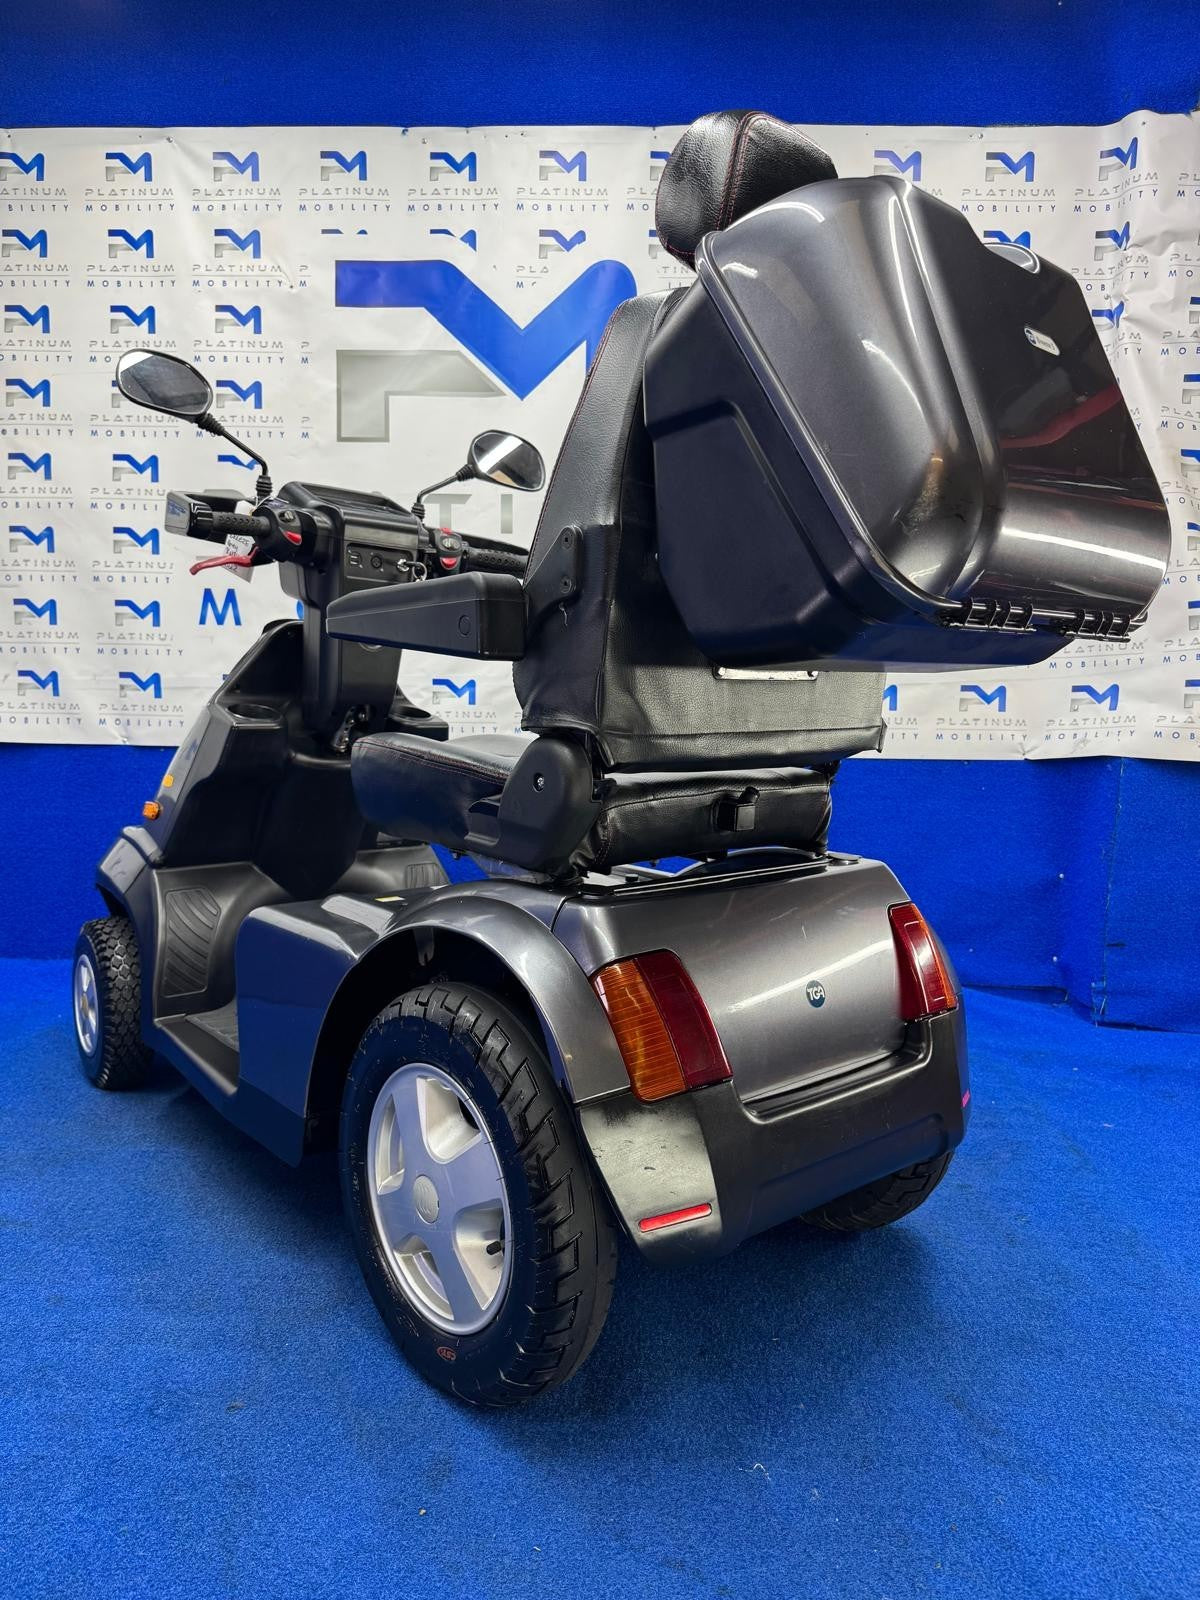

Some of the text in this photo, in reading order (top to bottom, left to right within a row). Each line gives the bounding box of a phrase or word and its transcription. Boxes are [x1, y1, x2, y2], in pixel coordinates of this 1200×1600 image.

[1075, 172, 1159, 197] PLATINUM
[85, 188, 174, 196] PLATINUM
[192, 188, 281, 196] PLATINUM
[299, 187, 390, 196] PLATINUM
[408, 187, 498, 196] PLATINUM
[516, 187, 608, 196] PLATINUM
[961, 189, 1056, 197] PLATINUM
[86, 203, 175, 212] MOBILITY
[193, 203, 282, 212] MOBILITY
[299, 203, 390, 212] MOBILITY
[408, 203, 499, 212] MOBILITY
[516, 203, 609, 212] MOBILITY
[962, 205, 1056, 213] MOBILITY
[87, 264, 175, 273] PLATINUM
[192, 264, 281, 272] PLATINUM
[87, 280, 176, 288] MOBILITY
[193, 280, 283, 288] MOBILITY
[89, 340, 176, 348] PLATINUM
[193, 340, 283, 348] PLATINUM
[194, 355, 284, 363] MOBILITY
[1050, 657, 1144, 669] MOBILITY
[99, 704, 183, 712] PLATINUM
[100, 719, 184, 727] MOBILITY
[936, 717, 1027, 726] PLATINUM
[1046, 716, 1136, 727] PLATINUM
[936, 733, 1027, 741] MOBILITY
[1045, 731, 1135, 740] MOBILITY
[807, 986, 825, 1000] TGA
